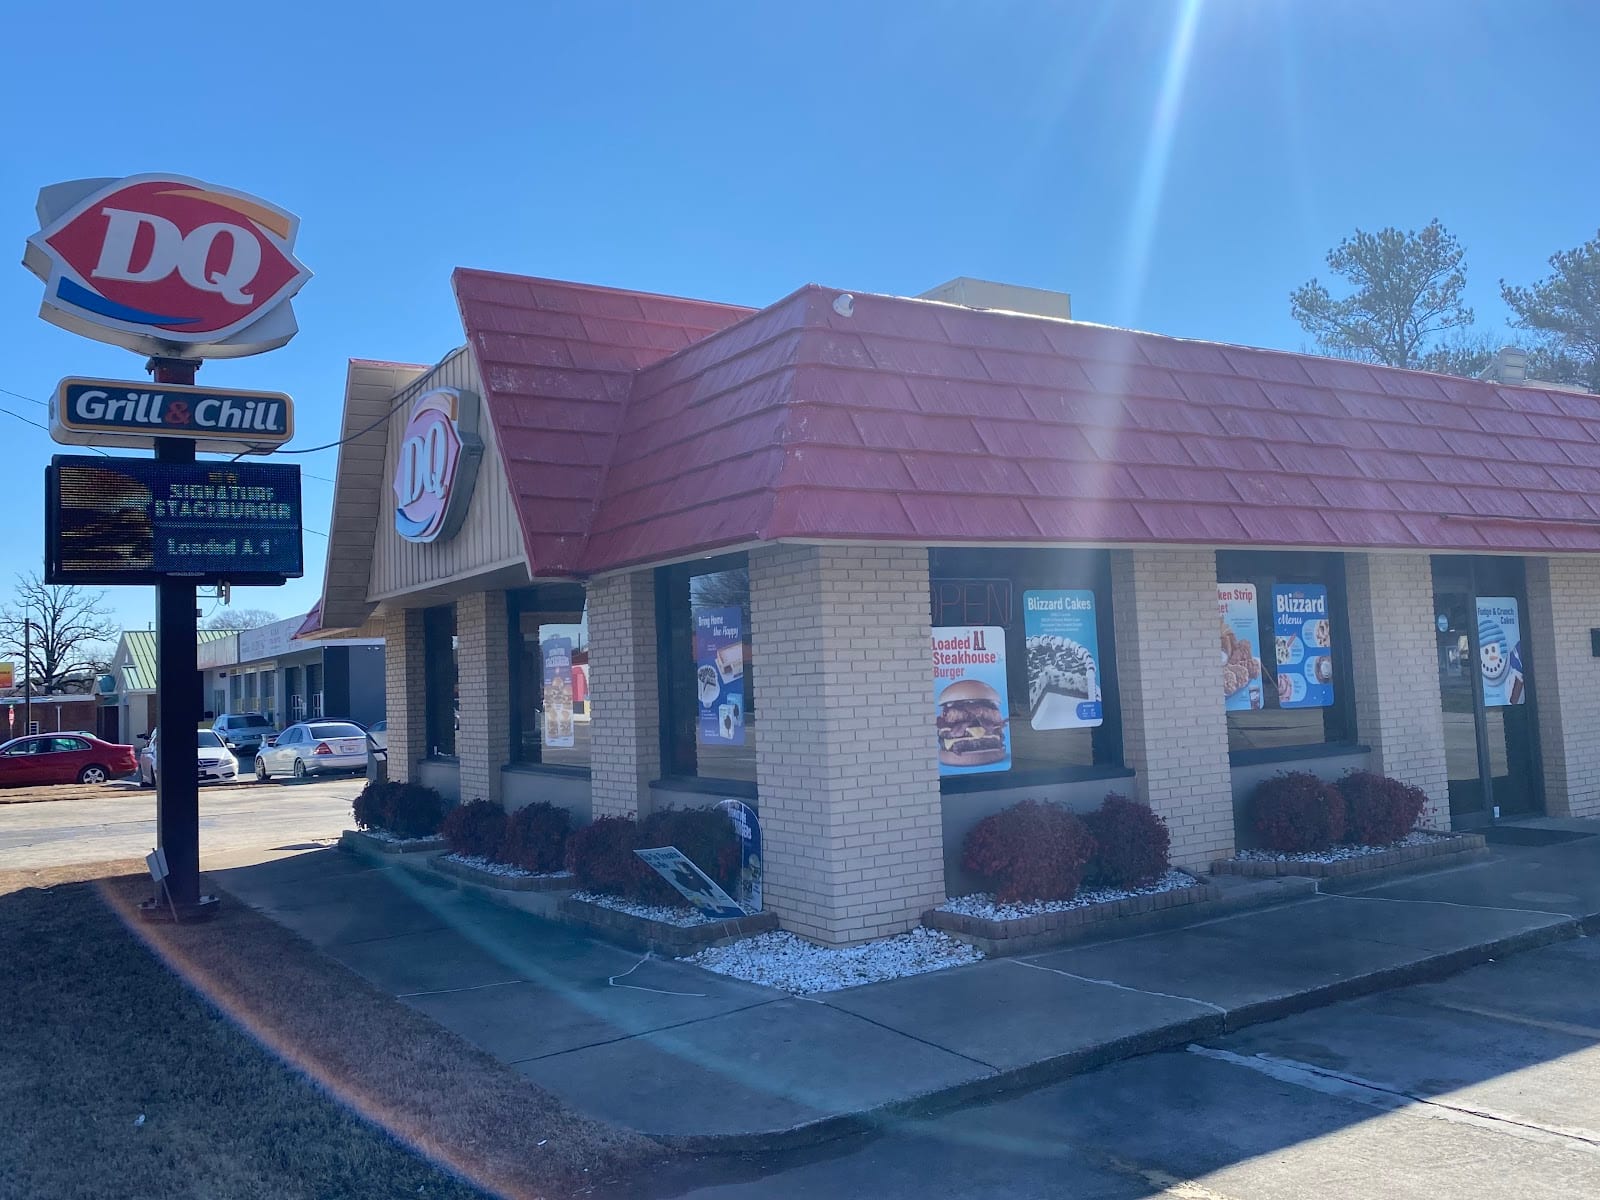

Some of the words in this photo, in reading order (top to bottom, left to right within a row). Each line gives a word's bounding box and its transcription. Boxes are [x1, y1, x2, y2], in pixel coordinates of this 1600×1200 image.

[91, 207, 262, 305] DQ
[75, 390, 164, 424] Grill
[194, 399, 279, 431] Chill
[399, 421, 449, 508] DQ
[167, 538, 237, 555] Loaded
[931, 583, 1008, 625] PEN
[1027, 596, 1063, 611] Blizzard
[1065, 597, 1092, 611] Cakes
[1233, 588, 1253, 604] Strip
[1276, 592, 1325, 613] Blizzard
[1277, 613, 1302, 625] Menu
[931, 636, 971, 651] Loaded
[933, 650, 996, 665] Steakhouse
[933, 666, 965, 681] Burger
